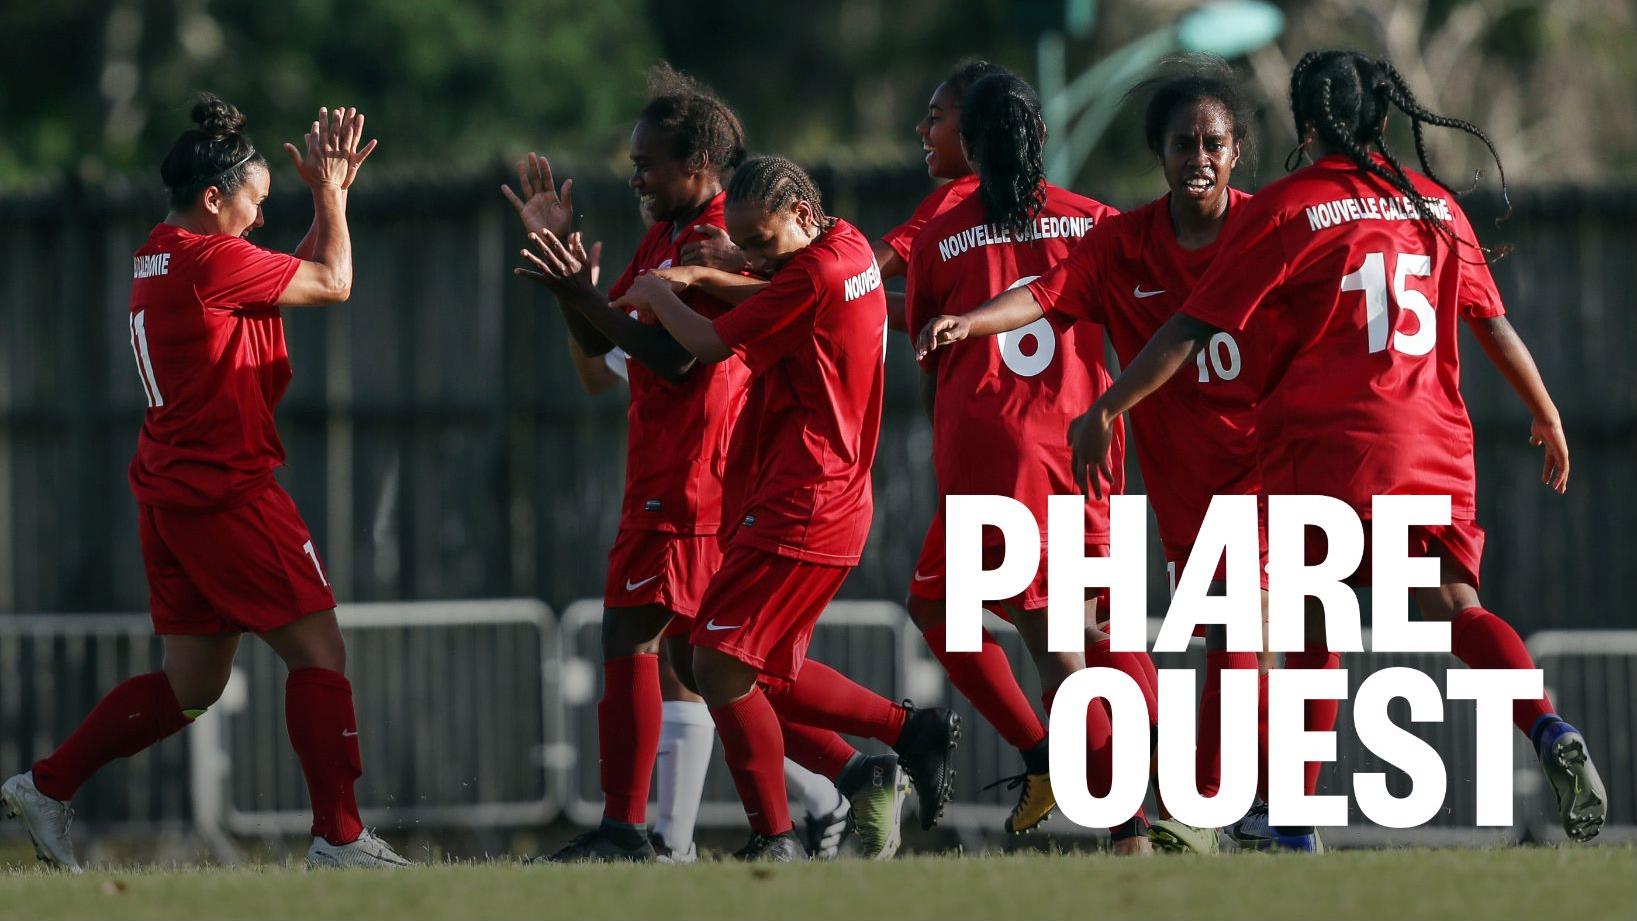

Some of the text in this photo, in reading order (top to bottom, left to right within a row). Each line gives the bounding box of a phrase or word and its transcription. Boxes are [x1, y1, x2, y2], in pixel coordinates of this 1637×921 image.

[938, 223, 1011, 262] NOUVELLE
[1306, 196, 1452, 231] NOUVELLE CALEDNIE
[996, 275, 1056, 377] 6
[1340, 252, 1437, 356] 15
[129, 309, 164, 407] 11
[1196, 331, 1241, 382] 10
